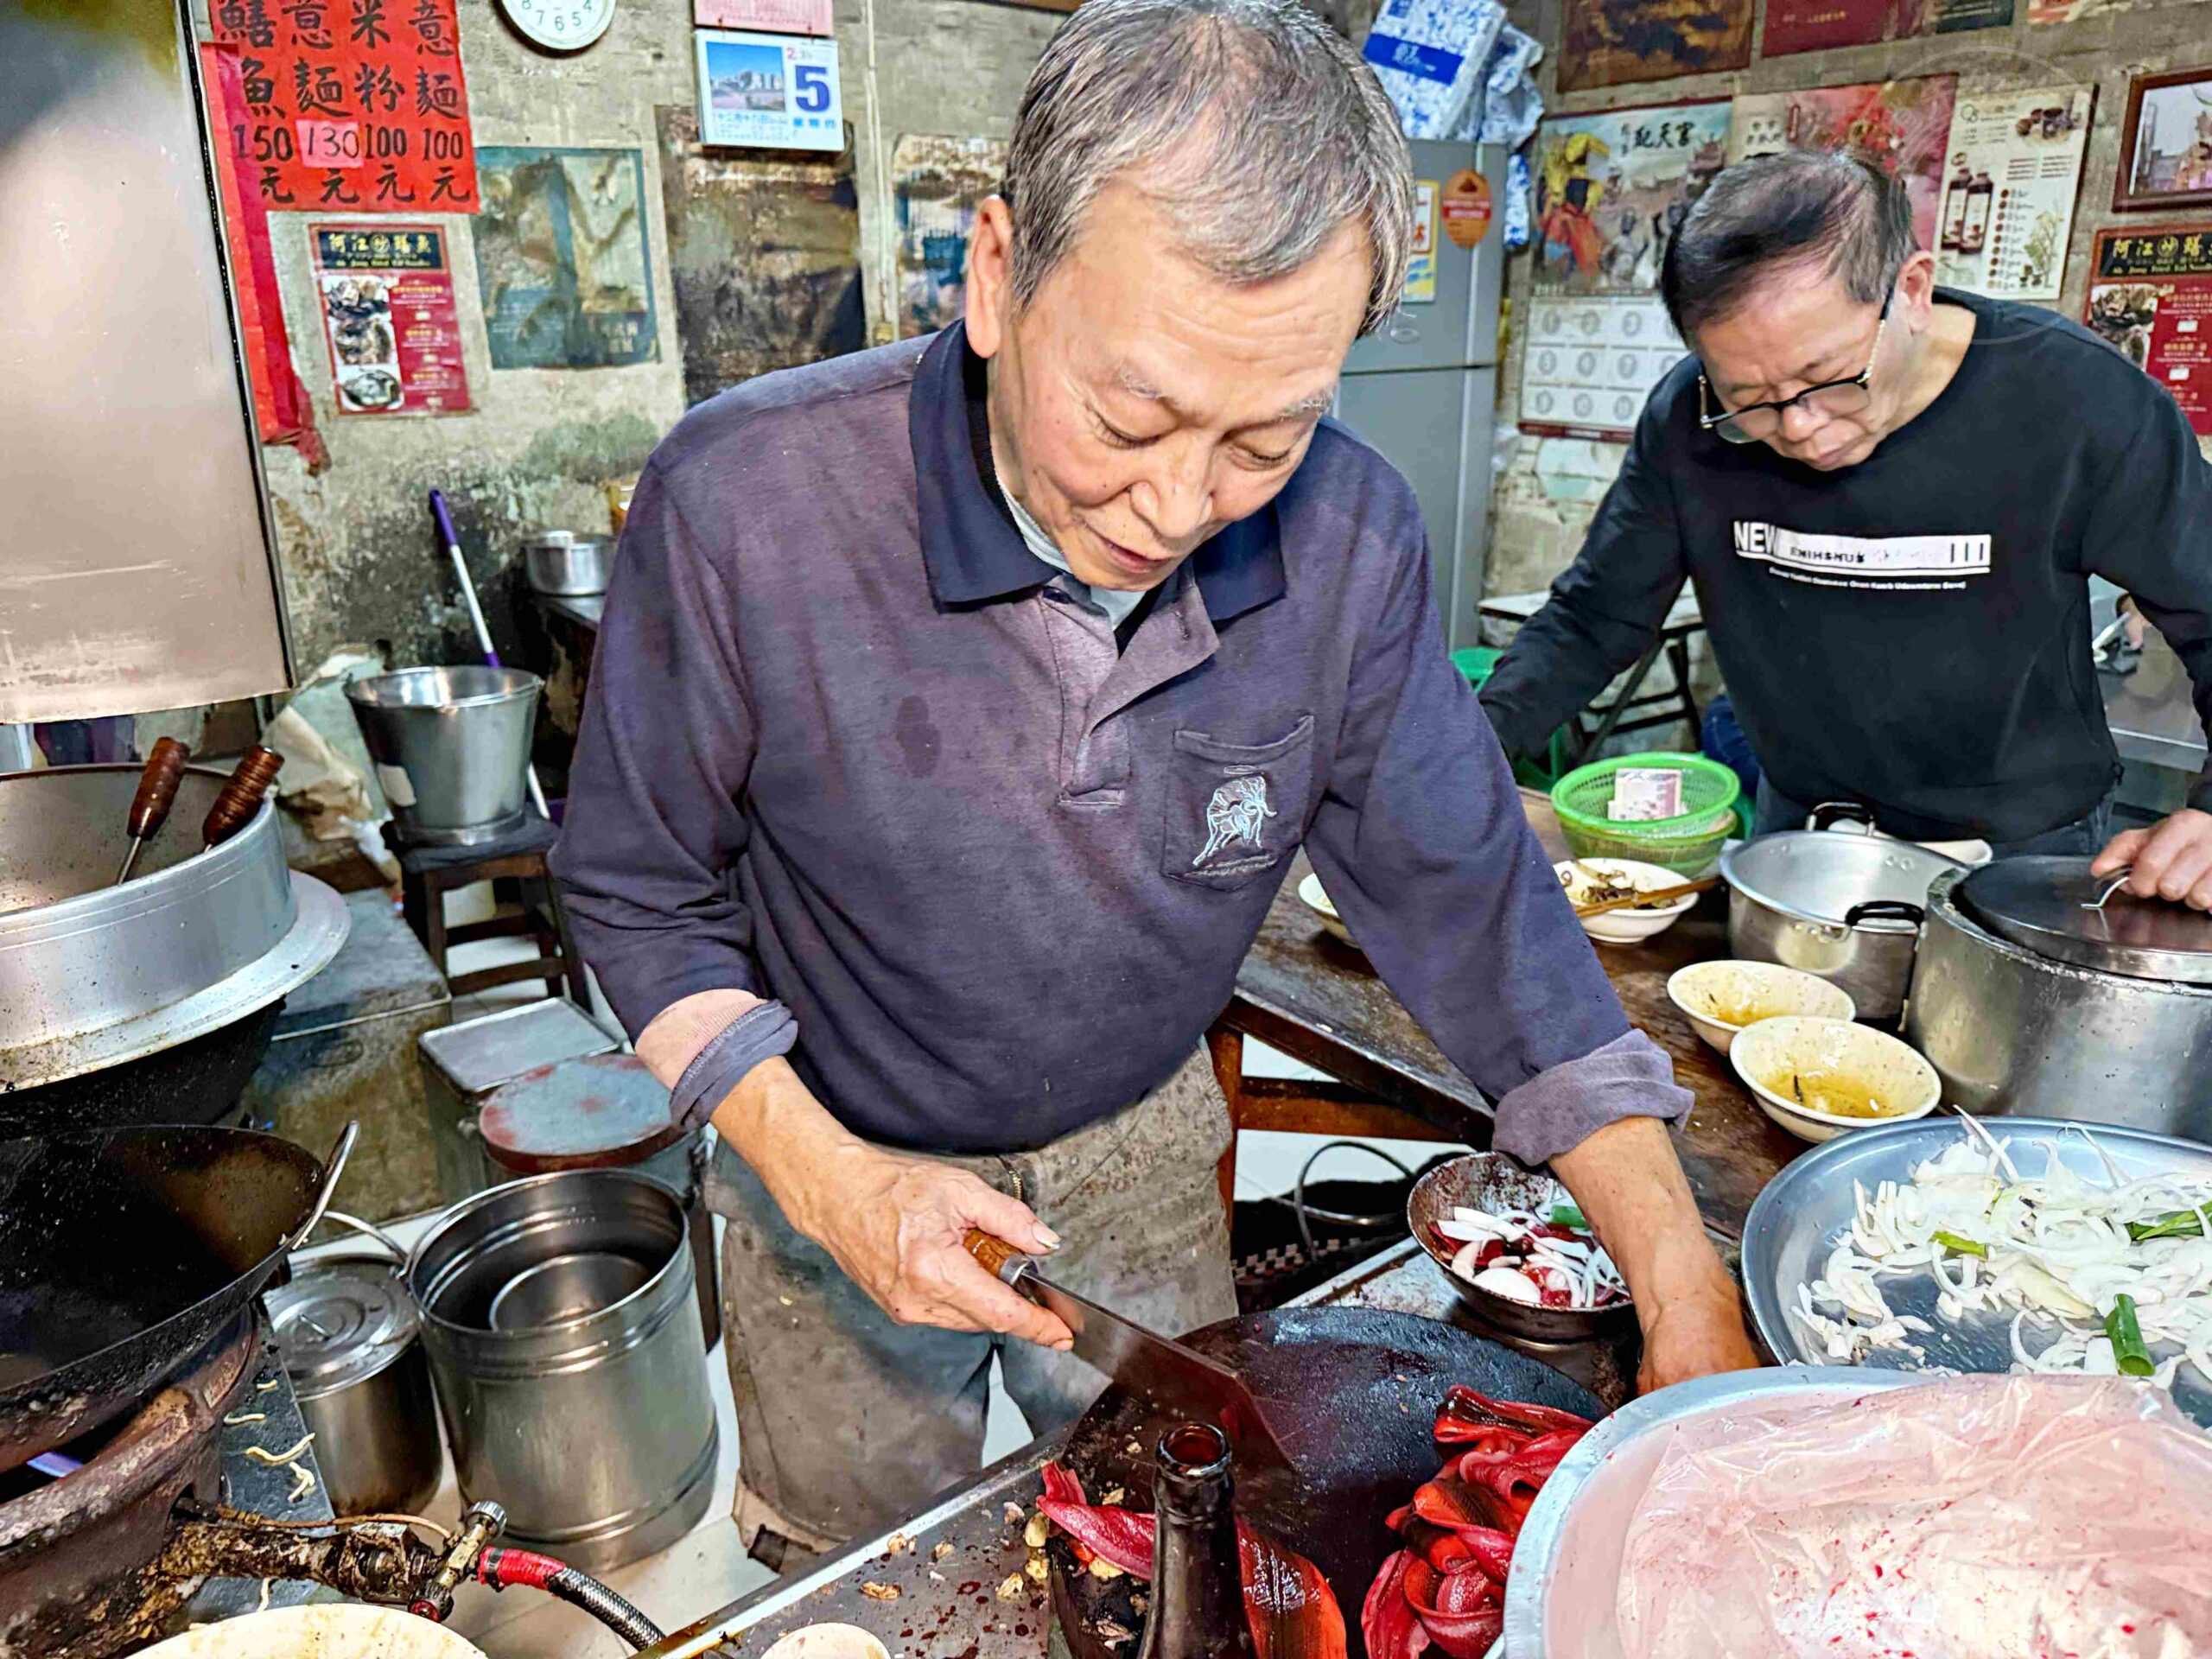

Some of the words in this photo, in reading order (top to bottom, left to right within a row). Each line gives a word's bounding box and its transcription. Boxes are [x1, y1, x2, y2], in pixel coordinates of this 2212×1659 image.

[536, 10, 544, 25] 7
[555, 16, 564, 31] 6
[572, 11, 582, 27] 5
[795, 65, 830, 112] 5
[233, 124, 293, 162] 150
[307, 126, 360, 159] 130
[365, 123, 407, 159] 100
[423, 129, 463, 161] 100
[260, 166, 296, 203] 元
[320, 168, 360, 203] 元
[377, 164, 416, 202] 元
[429, 166, 471, 202] 元
